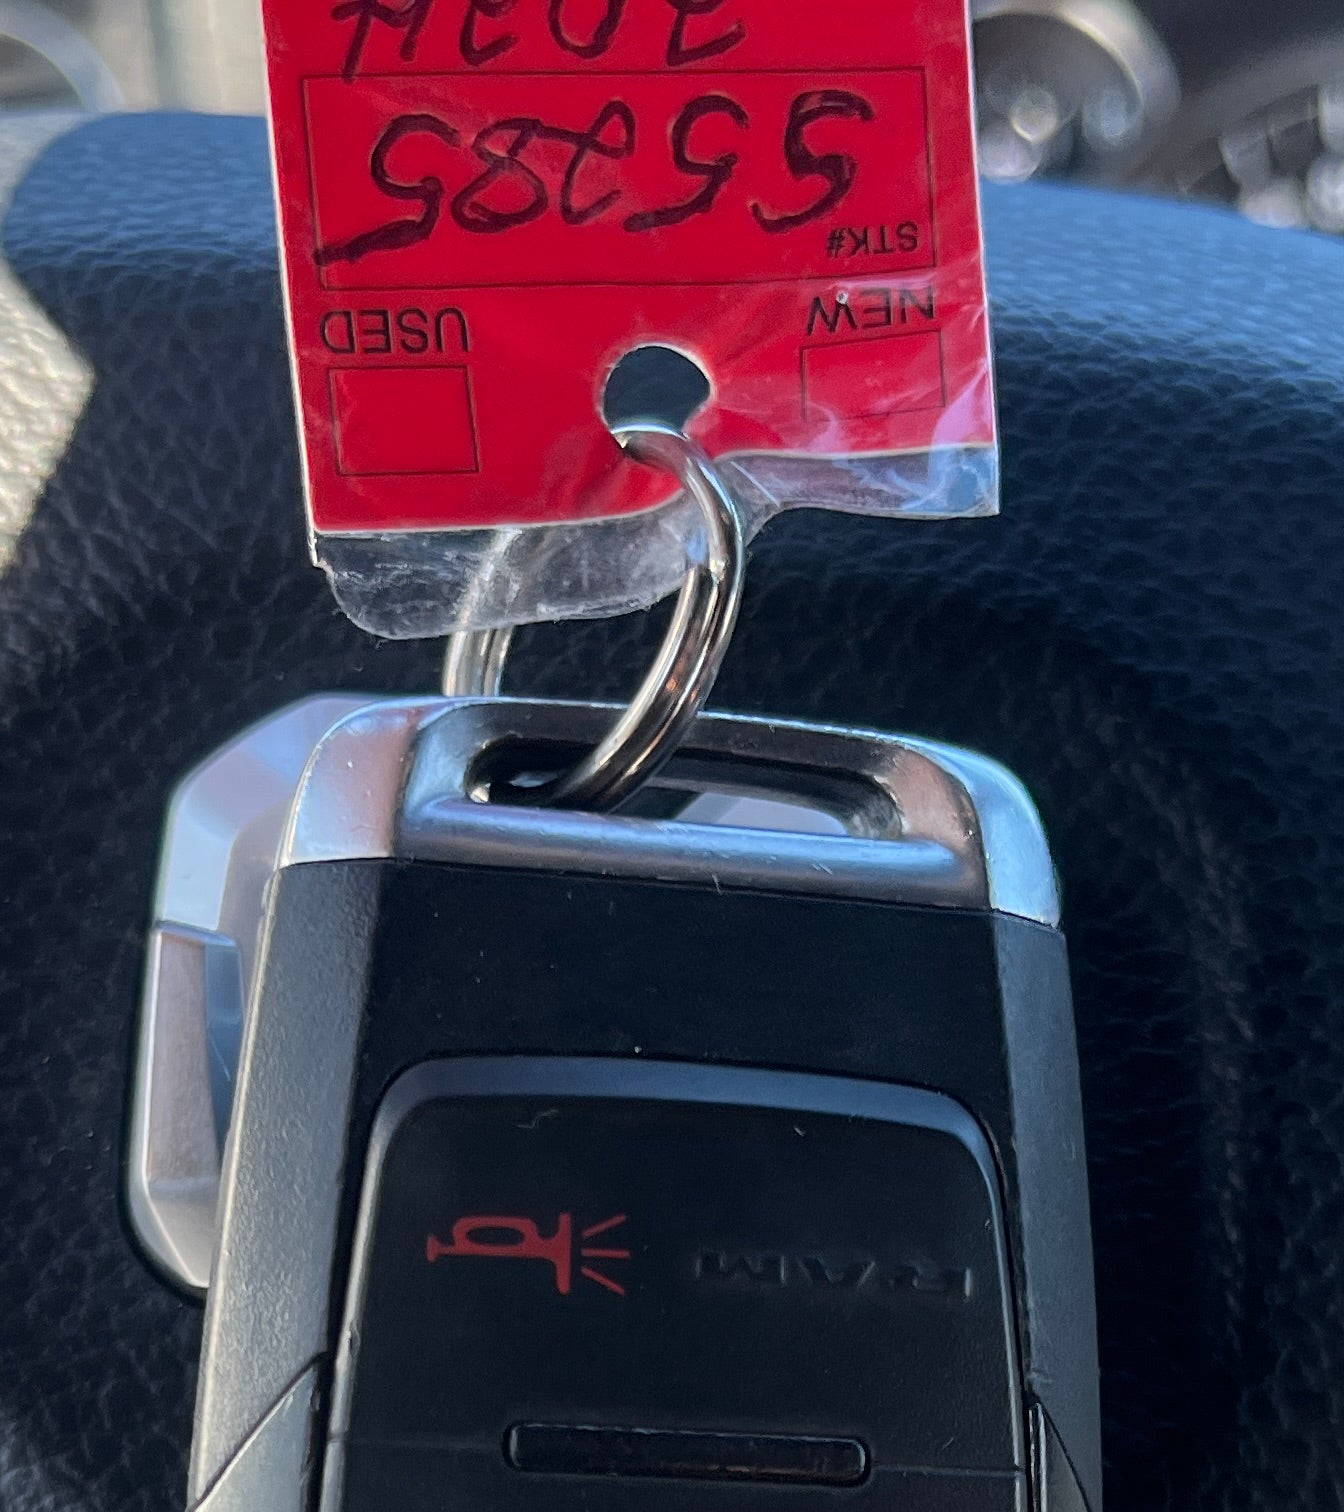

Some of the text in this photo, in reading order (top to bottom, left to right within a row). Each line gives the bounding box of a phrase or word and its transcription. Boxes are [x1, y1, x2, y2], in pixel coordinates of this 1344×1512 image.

[825, 222, 920, 260] STK#
[320, 306, 471, 354] USED
[804, 286, 936, 338] NEW
